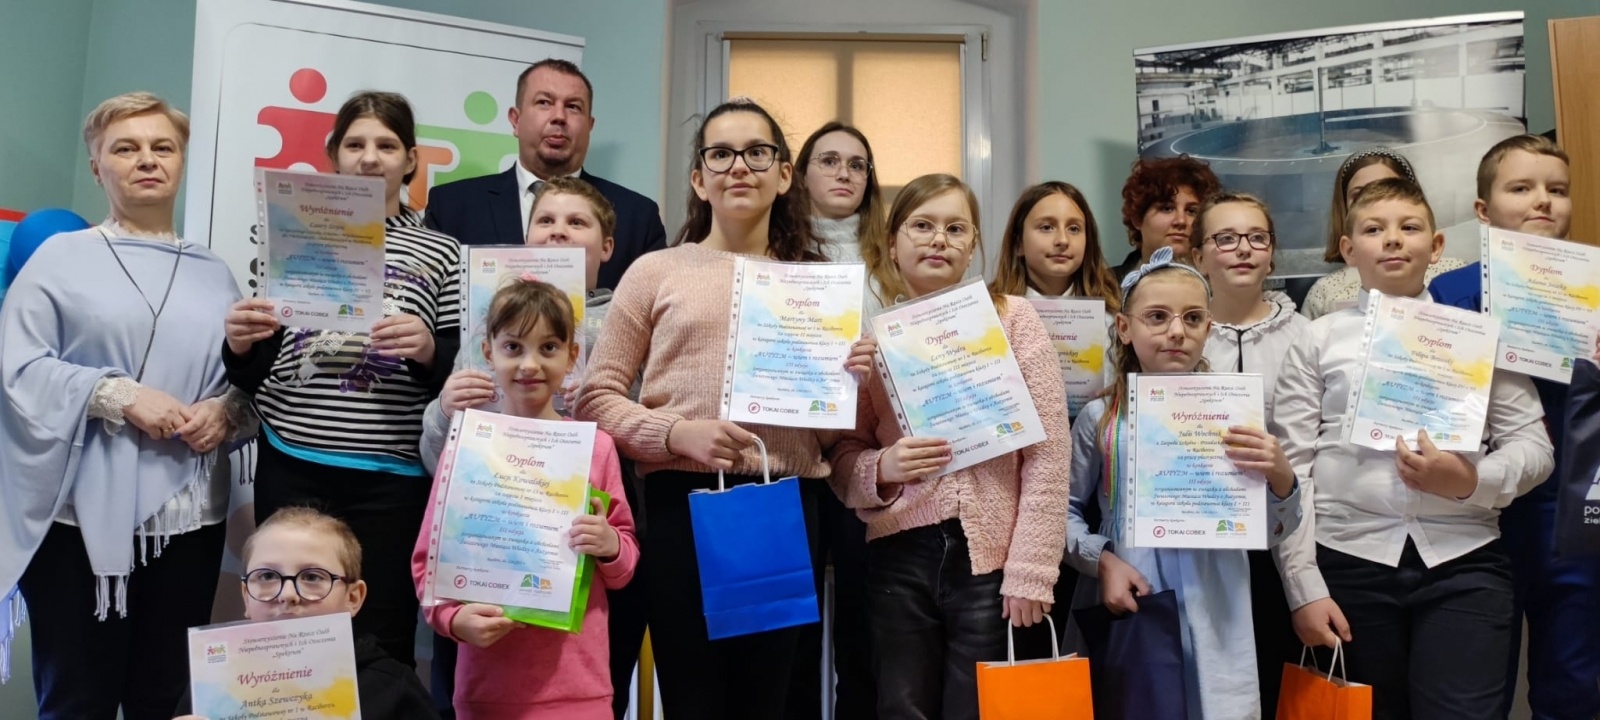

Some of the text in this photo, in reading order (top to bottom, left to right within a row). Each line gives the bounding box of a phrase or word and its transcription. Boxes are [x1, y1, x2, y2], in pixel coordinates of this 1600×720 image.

[300, 205, 353, 216] Wyróżnienie
[1530, 264, 1562, 276] Dyplom
[785, 298, 820, 309] Dyplom
[925, 329, 959, 346] Dyplom
[1417, 335, 1452, 349] Dyplom
[1172, 412, 1229, 423] Wyróżnienie
[954, 441, 989, 456] TOKAI COBEX
[506, 454, 545, 468] Dyplom
[238, 667, 312, 688] Wyróżnienie
[240, 692, 312, 710] Antka Szewczyka
